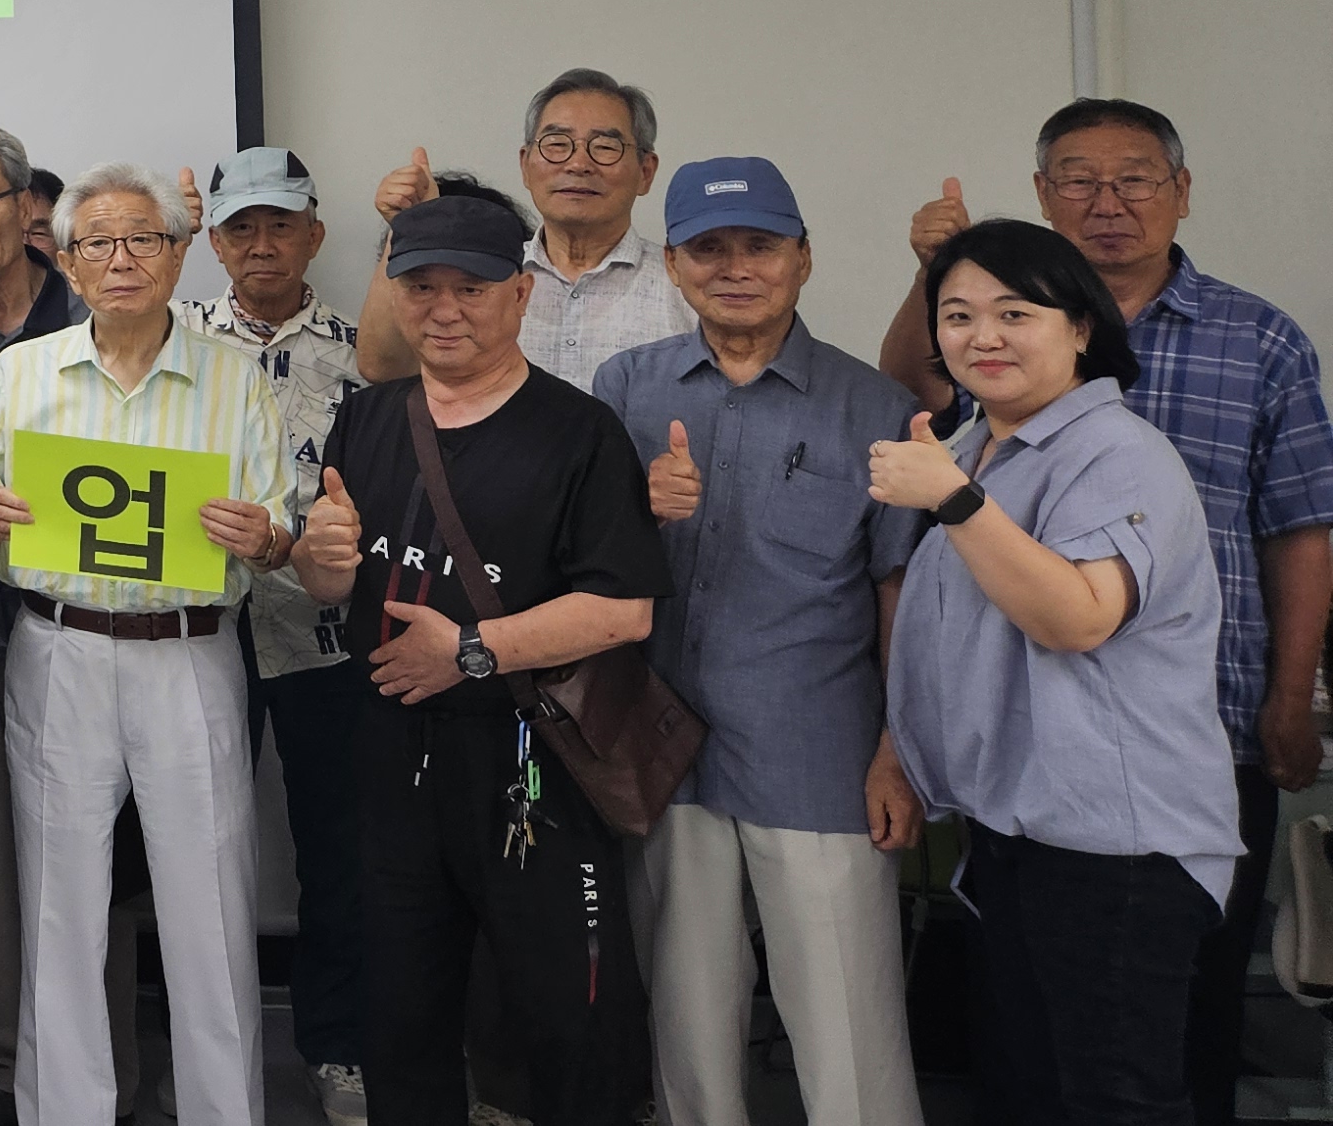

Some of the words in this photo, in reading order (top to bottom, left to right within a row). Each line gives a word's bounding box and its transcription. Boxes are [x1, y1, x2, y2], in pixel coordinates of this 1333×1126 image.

[62, 465, 166, 582] 업
[370, 535, 502, 583] ARIS
[580, 863, 599, 927] PARIS
